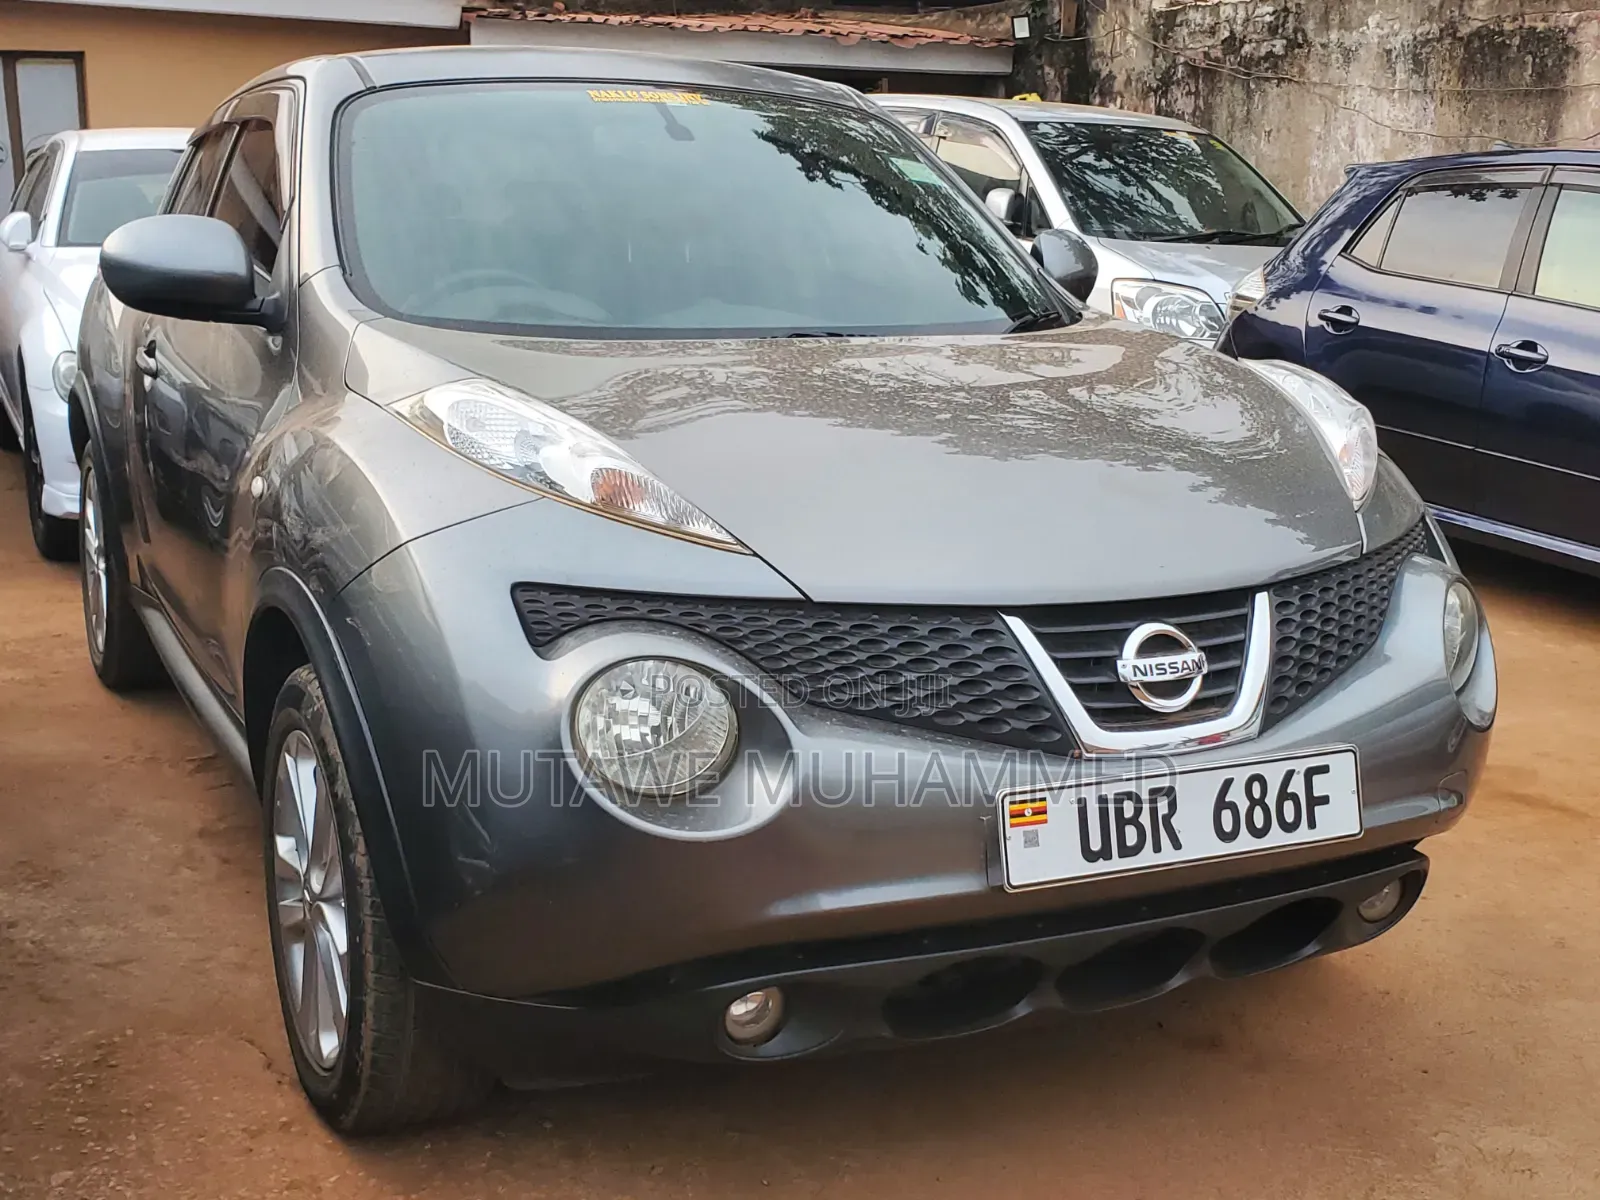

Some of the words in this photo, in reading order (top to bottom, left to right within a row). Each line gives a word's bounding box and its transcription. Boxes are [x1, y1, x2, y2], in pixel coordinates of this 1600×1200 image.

[1132, 658, 1205, 677] NISSAN
[1076, 785, 1183, 864] UBR
[1212, 764, 1331, 844] 686F
